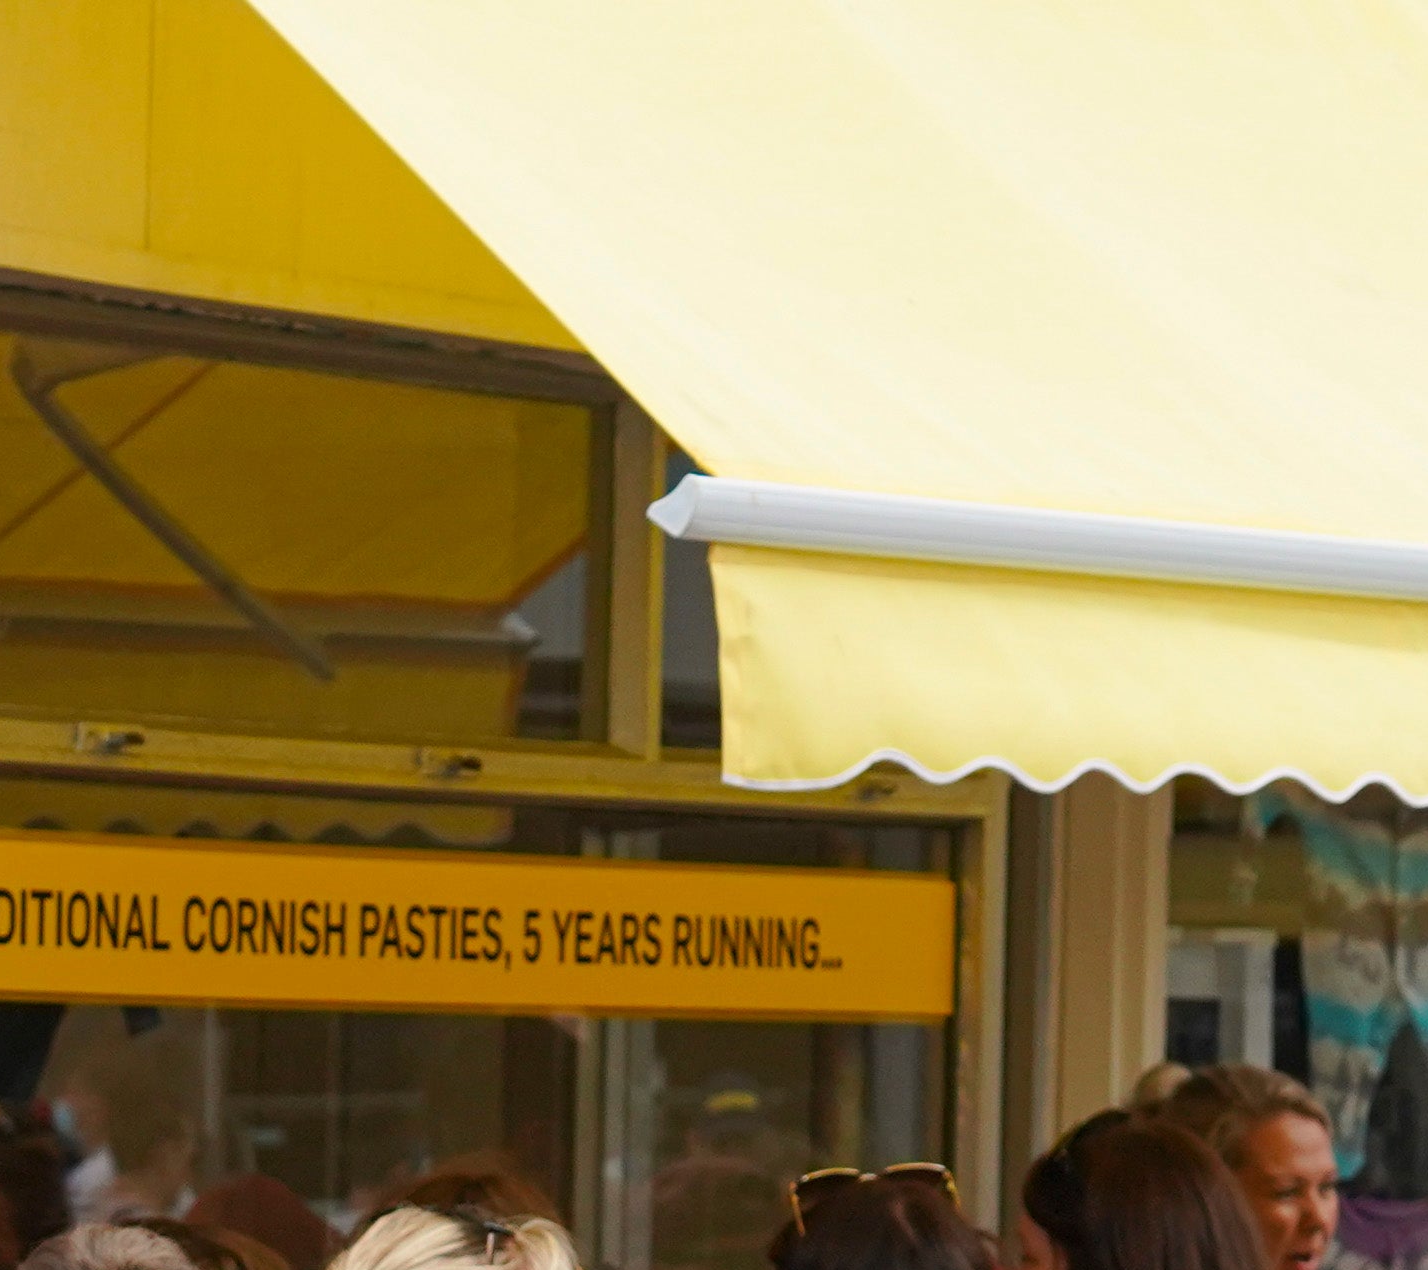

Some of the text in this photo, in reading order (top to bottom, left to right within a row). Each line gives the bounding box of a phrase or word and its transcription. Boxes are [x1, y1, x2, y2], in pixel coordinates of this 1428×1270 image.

[182, 896, 347, 958] CORNISH
[358, 904, 513, 972] PASTIES,
[522, 909, 542, 964] 5
[552, 910, 662, 966] YEARS
[672, 913, 843, 970] RUNNING...
